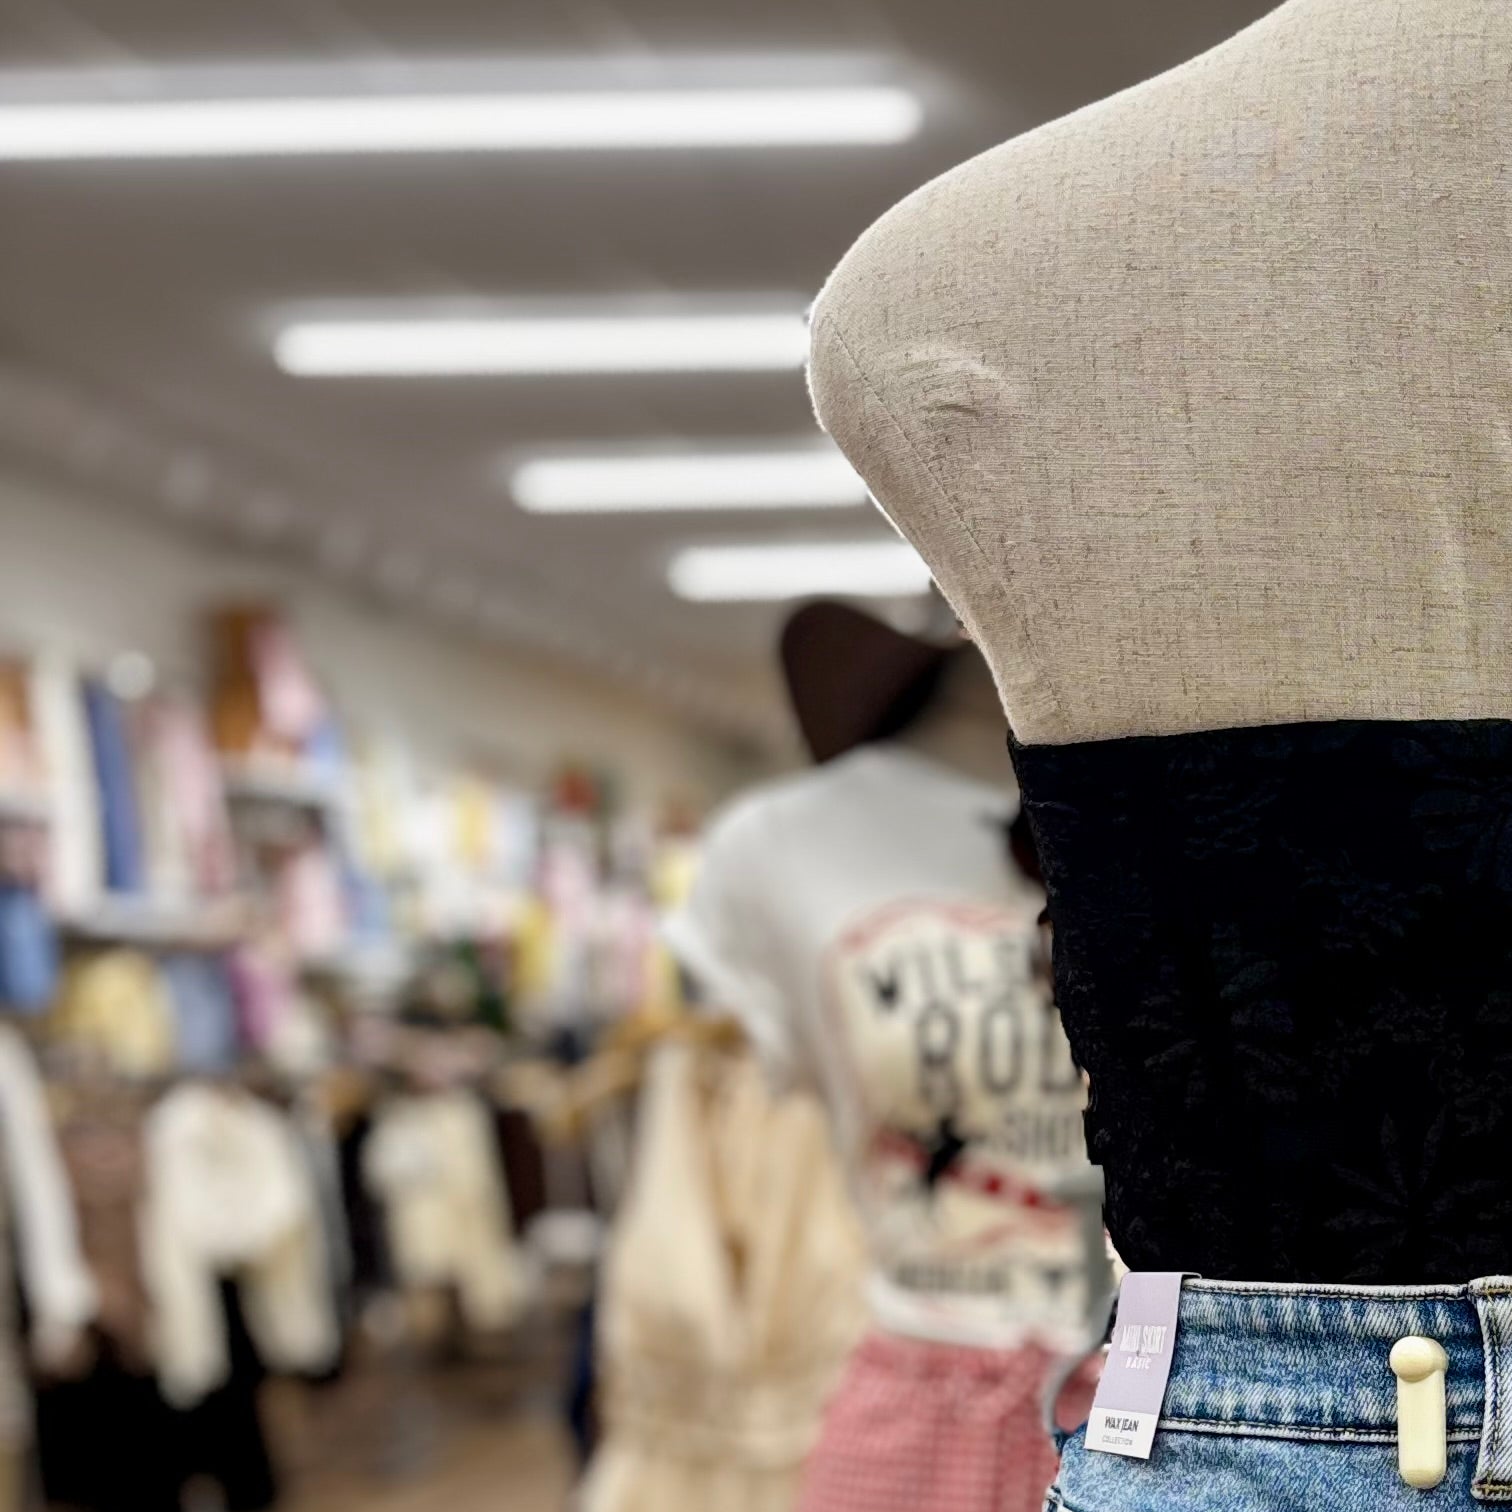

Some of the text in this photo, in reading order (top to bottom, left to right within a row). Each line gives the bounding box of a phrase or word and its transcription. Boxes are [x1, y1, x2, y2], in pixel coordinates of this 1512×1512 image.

[1125, 1356, 1152, 1370] BASIC
[1105, 1415, 1139, 1433] WAX JEAN
[1102, 1435, 1133, 1446] COLLECTION
